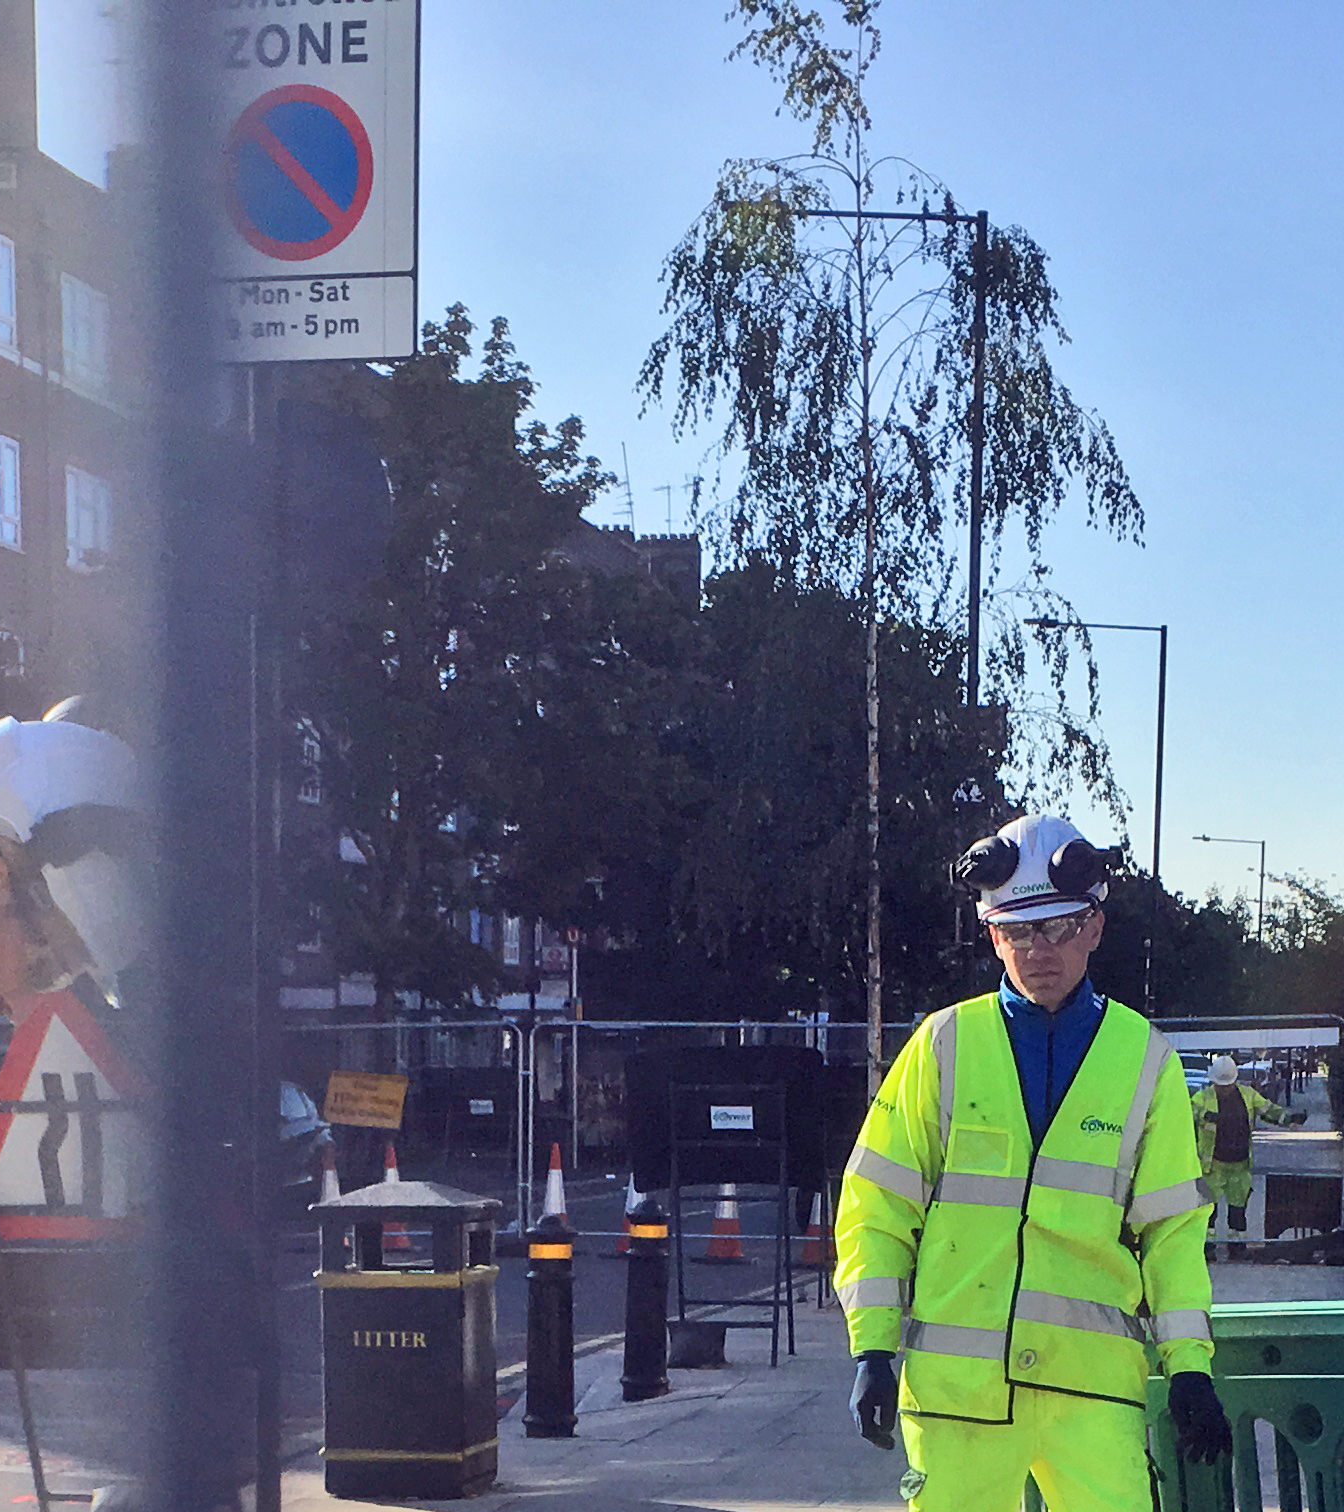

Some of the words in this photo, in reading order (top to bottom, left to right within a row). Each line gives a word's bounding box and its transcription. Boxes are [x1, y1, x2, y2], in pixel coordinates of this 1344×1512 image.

[225, 20, 368, 68] ZONE
[1011, 882, 1054, 895] CONWA
[1080, 1119, 1123, 1135] CONWA
